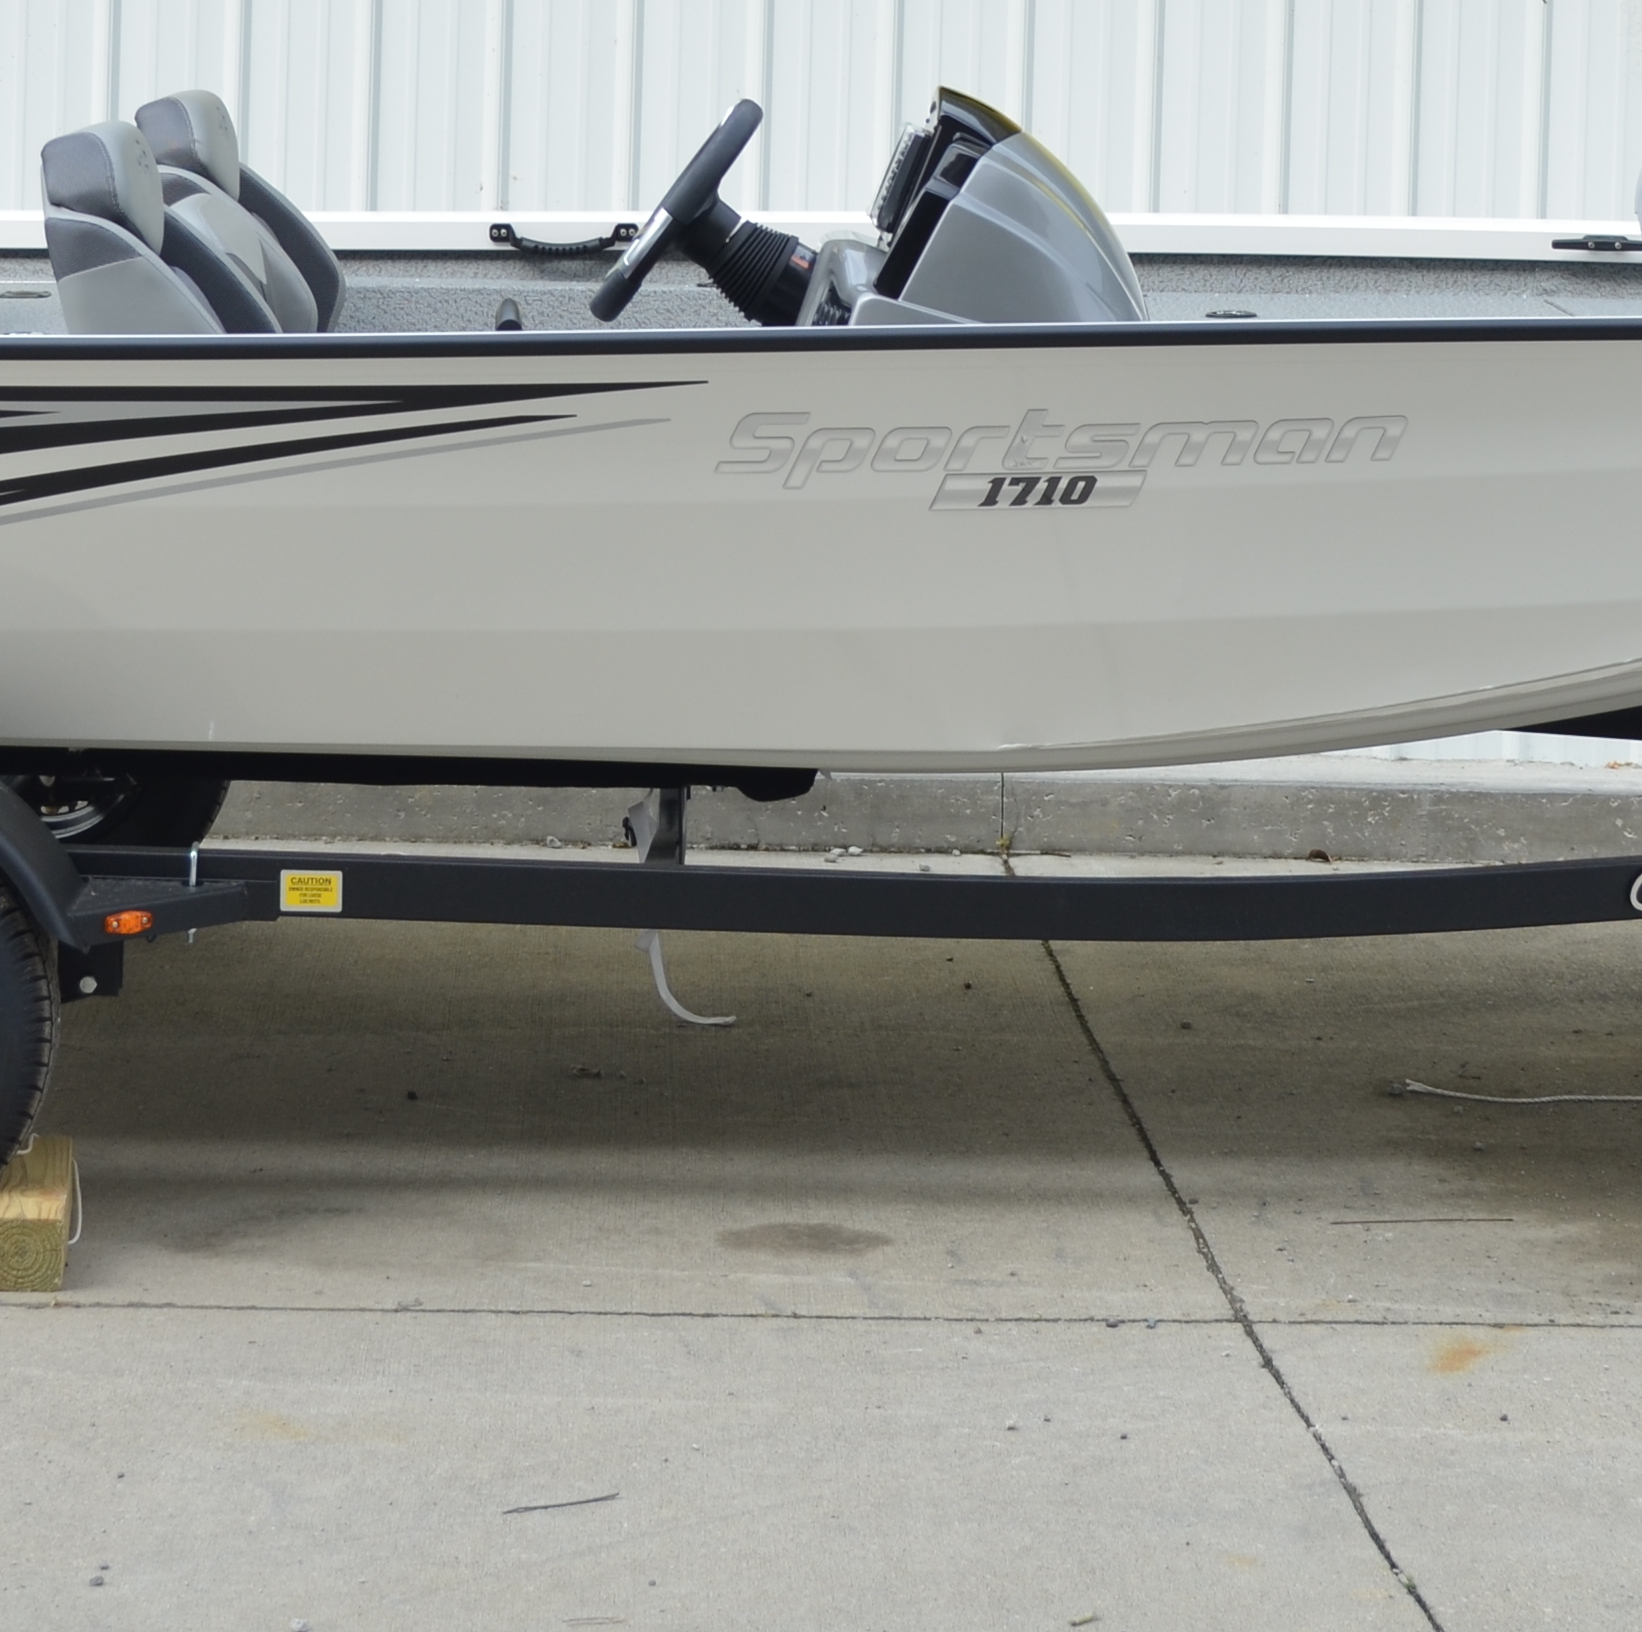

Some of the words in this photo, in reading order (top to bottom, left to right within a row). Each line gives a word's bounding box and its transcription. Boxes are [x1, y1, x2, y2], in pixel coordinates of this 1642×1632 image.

[714, 408, 1409, 489] Sportsman
[978, 475, 1098, 507] 1710
[290, 877, 332, 886] CAUTION
